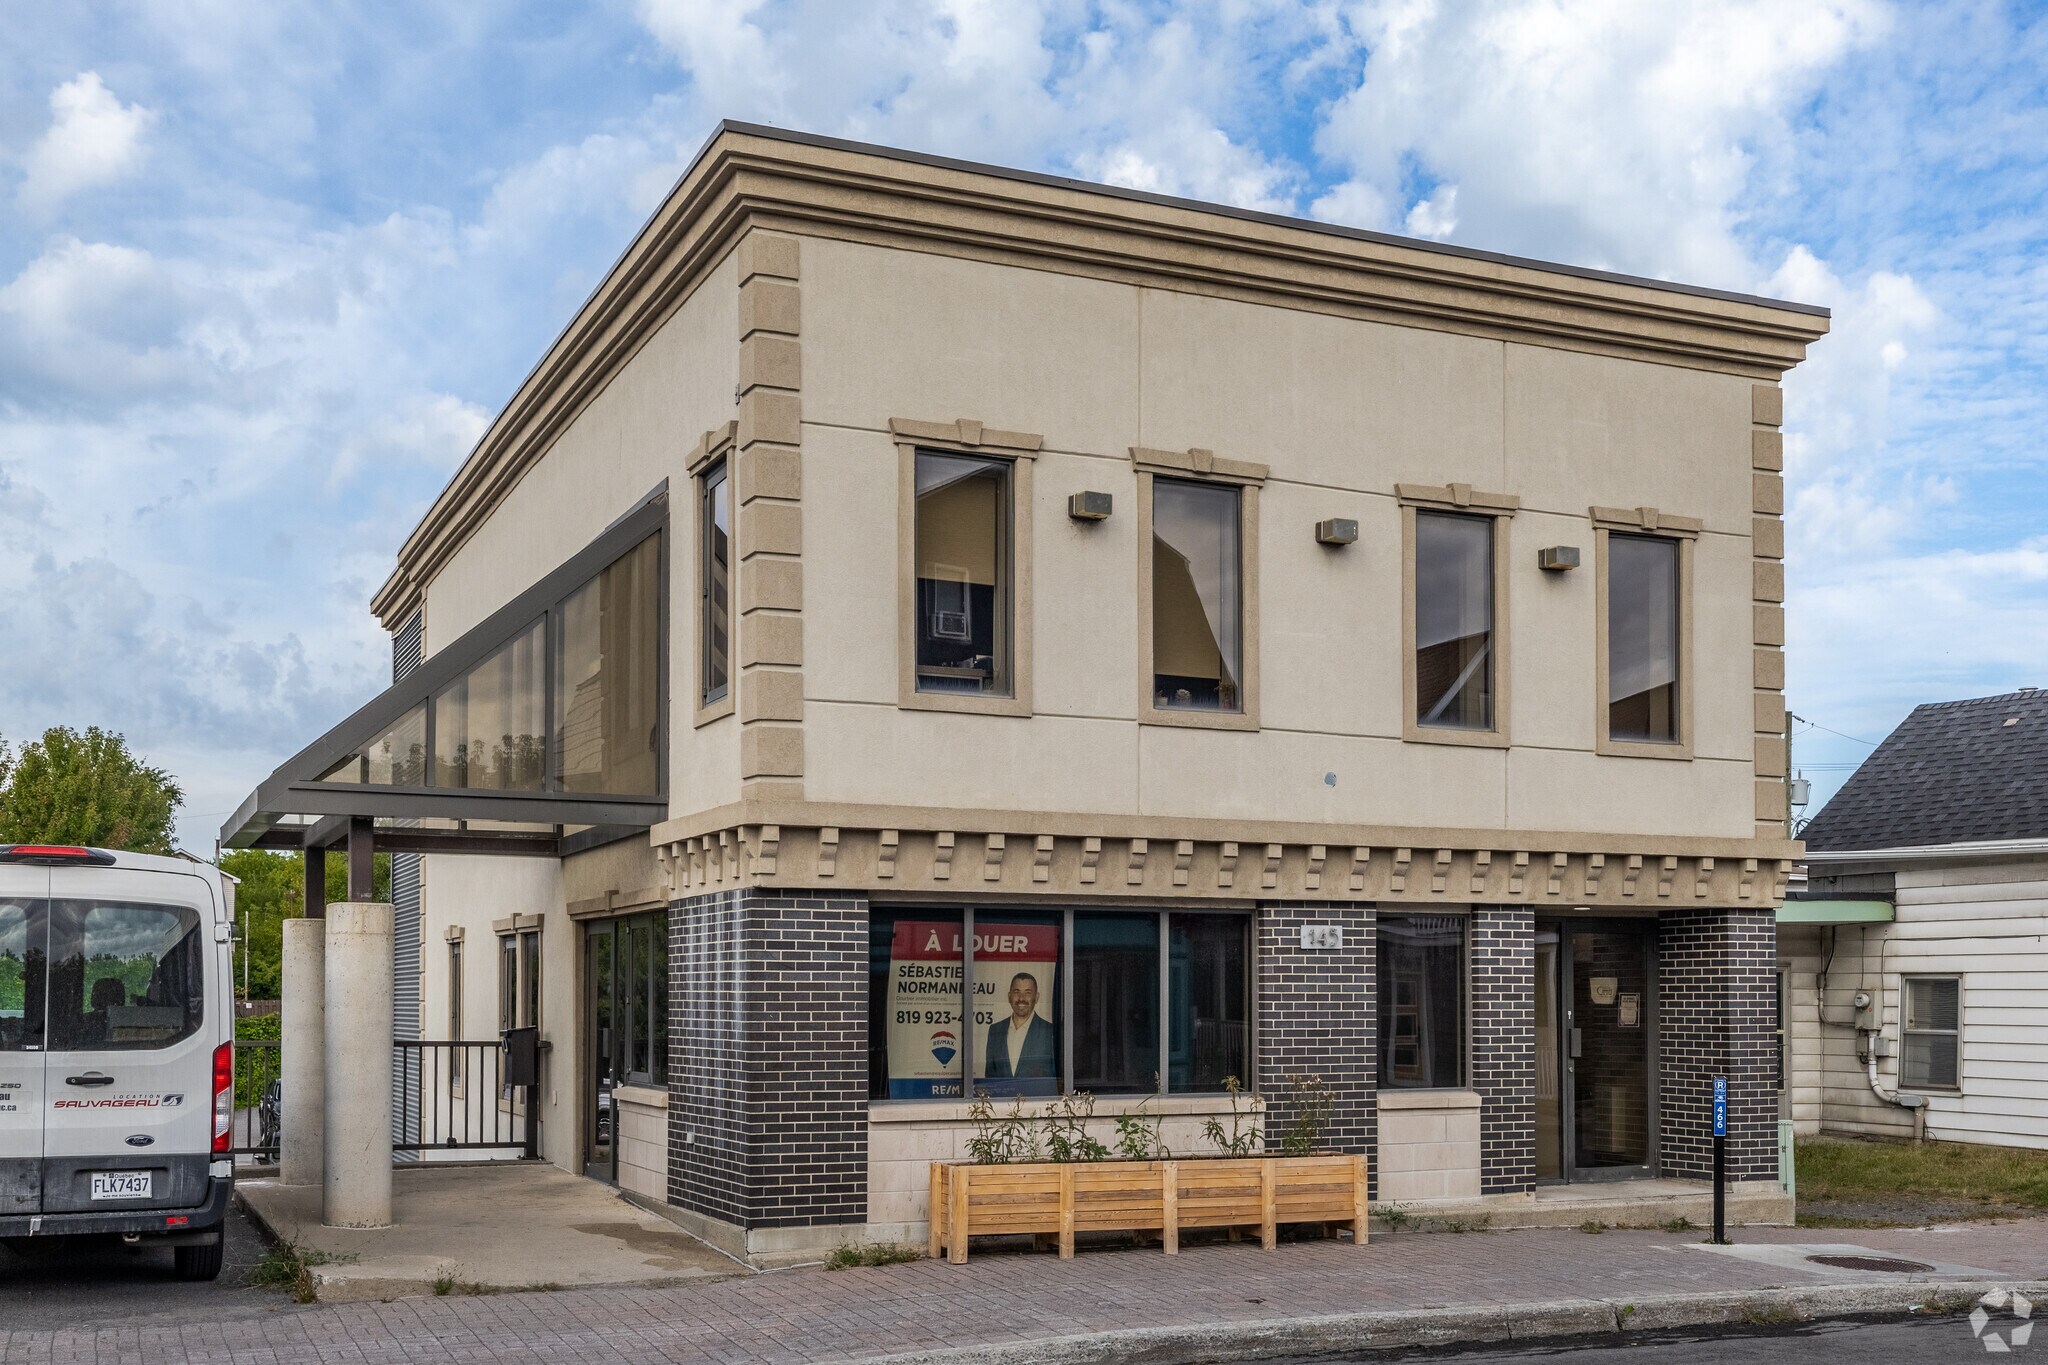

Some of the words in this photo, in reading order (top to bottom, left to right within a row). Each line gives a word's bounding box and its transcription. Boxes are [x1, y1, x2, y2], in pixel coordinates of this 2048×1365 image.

[924, 929, 942, 952] À
[1308, 927, 1339, 948] 145
[898, 962, 964, 979] SÉBASTIE
[896, 1010, 921, 1024] 819
[925, 1011, 993, 1025] 923-403
[0, 1104, 17, 1112] c.ca
[54, 1099, 159, 1108] SAUVAGEAU
[1716, 1105, 1724, 1129] 466
[94, 1178, 149, 1193] FLK7437
